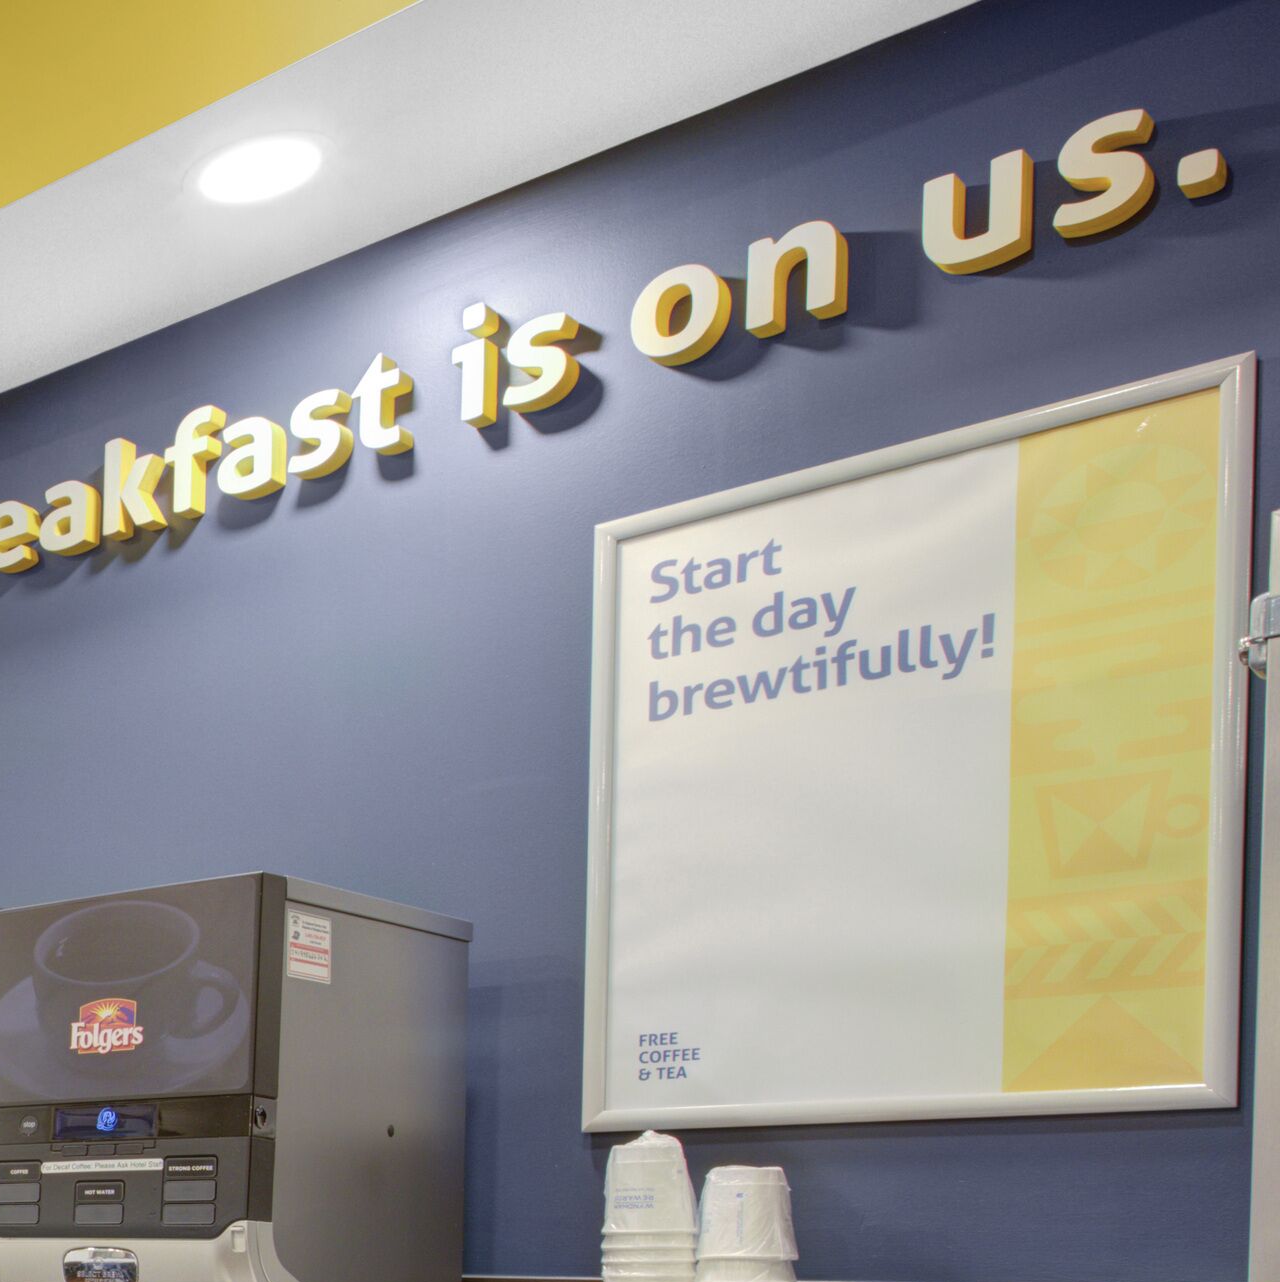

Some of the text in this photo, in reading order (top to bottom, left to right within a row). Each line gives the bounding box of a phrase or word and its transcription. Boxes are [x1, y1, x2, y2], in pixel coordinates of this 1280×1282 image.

[452, 301, 581, 428] is
[630, 219, 849, 367] on
[923, 108, 1228, 276] us.
[649, 538, 783, 604] Start
[647, 586, 857, 660] the day
[648, 612, 995, 722] brewtifully!
[70, 1022, 144, 1054] Folgers
[639, 1032, 679, 1047] FREE
[639, 1048, 701, 1064] COFFEE
[638, 1065, 687, 1081] & TEA
